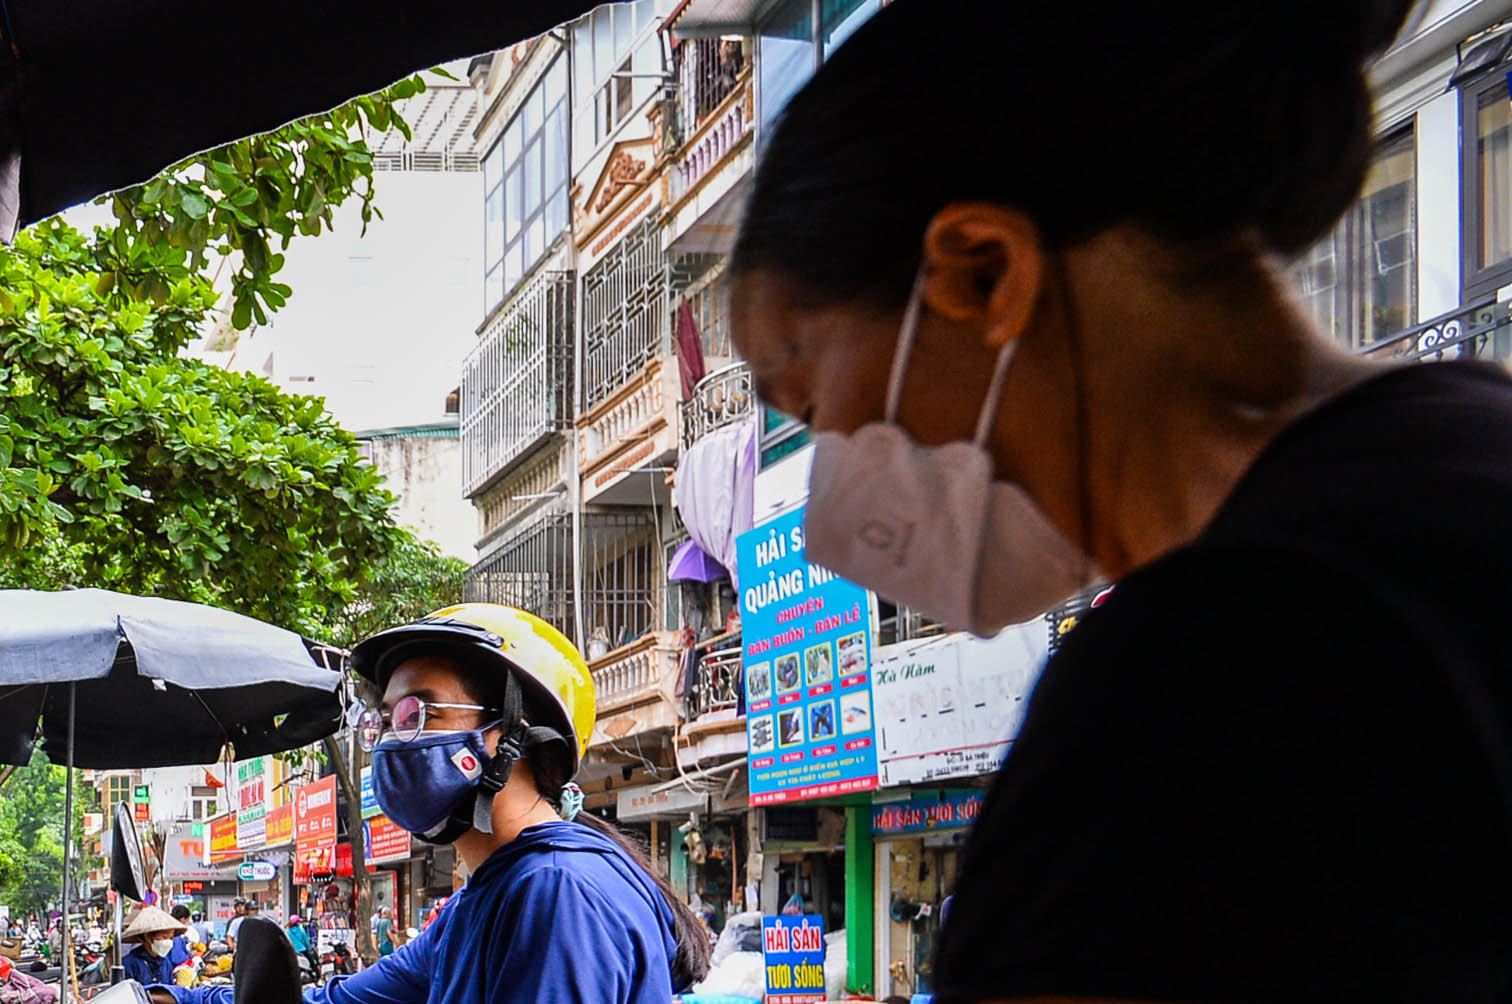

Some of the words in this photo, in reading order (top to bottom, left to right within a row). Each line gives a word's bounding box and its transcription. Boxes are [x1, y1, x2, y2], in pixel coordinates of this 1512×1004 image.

[755, 528, 787, 568] HẢI
[745, 570, 805, 614] QUẢNG
[776, 597, 824, 624] CHUYÊN
[748, 638, 770, 656] BÁN
[772, 627, 805, 648] BUÔN
[815, 614, 841, 634] BÁN
[843, 602, 861, 624] LẺ
[874, 806, 895, 829] HẢI
[897, 803, 921, 827] SẢN
[765, 919, 789, 953] HẢI
[792, 918, 821, 952] SẢN
[767, 963, 792, 988] TƯƠI
[794, 957, 824, 988] SỐNG
